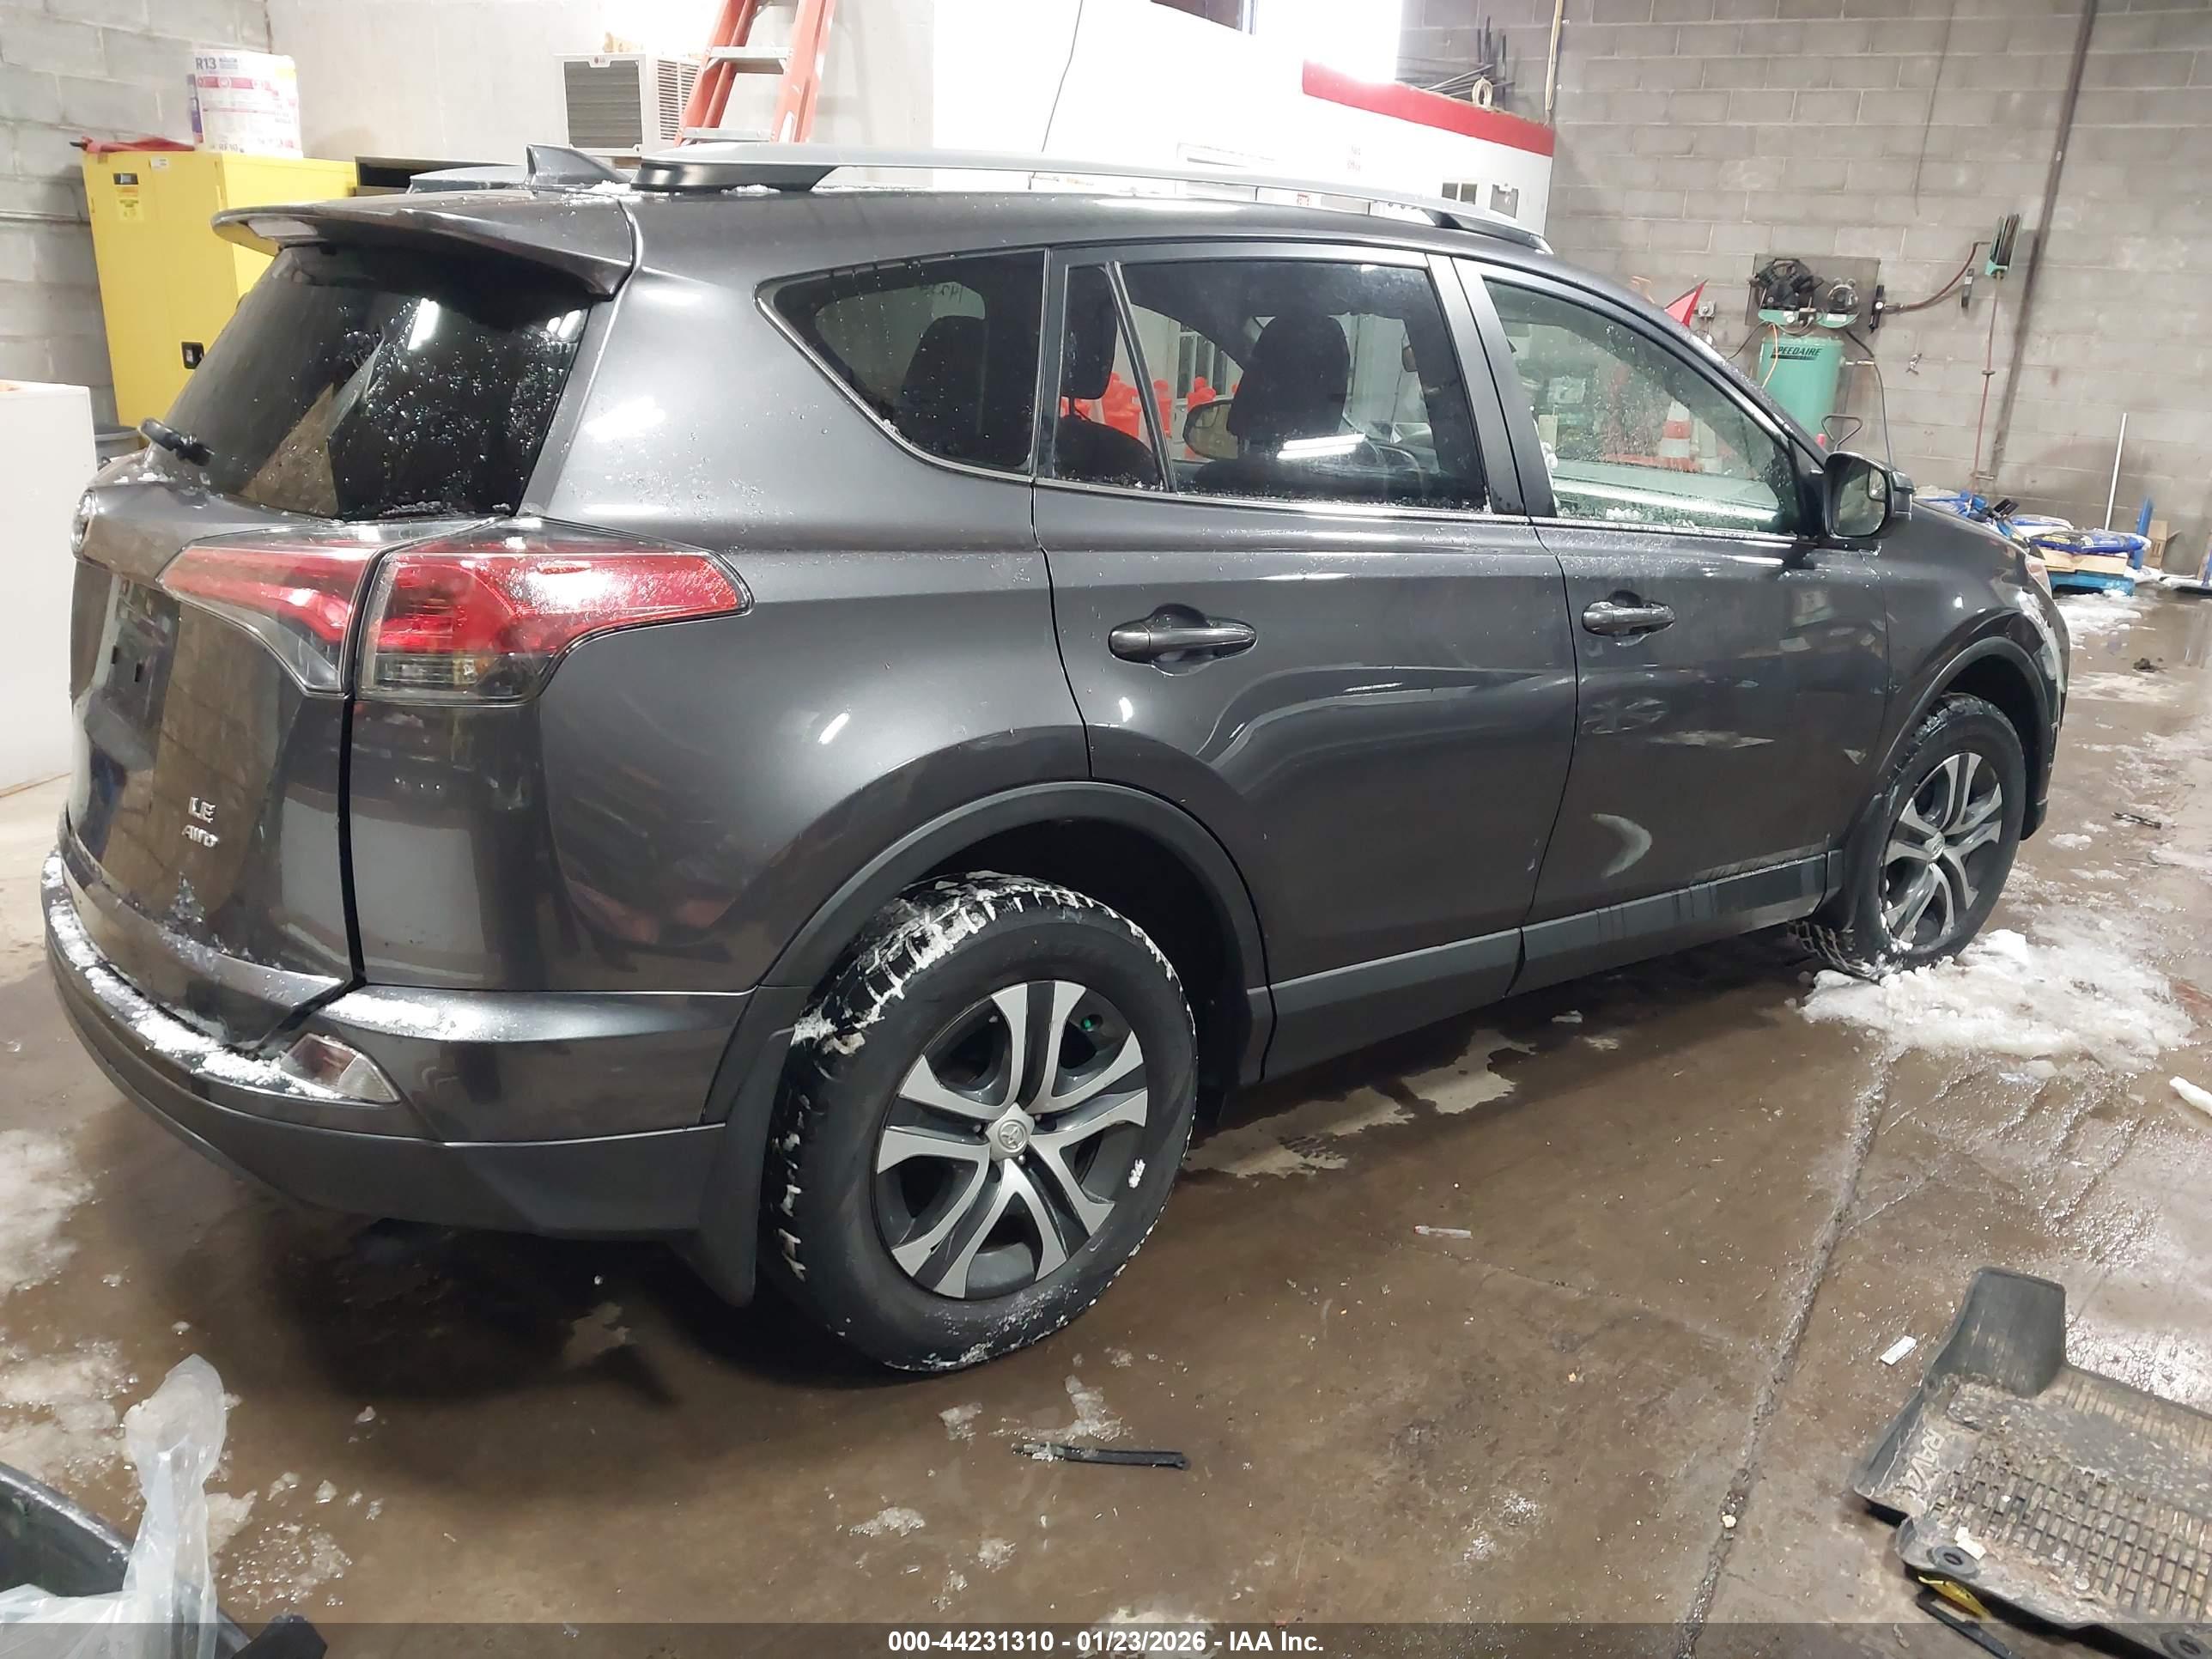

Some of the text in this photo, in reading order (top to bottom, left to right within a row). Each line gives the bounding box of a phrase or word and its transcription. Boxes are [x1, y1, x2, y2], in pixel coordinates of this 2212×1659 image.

[195, 57, 217, 70] R13
[188, 796, 216, 823] LE
[181, 824, 219, 848] AWD
